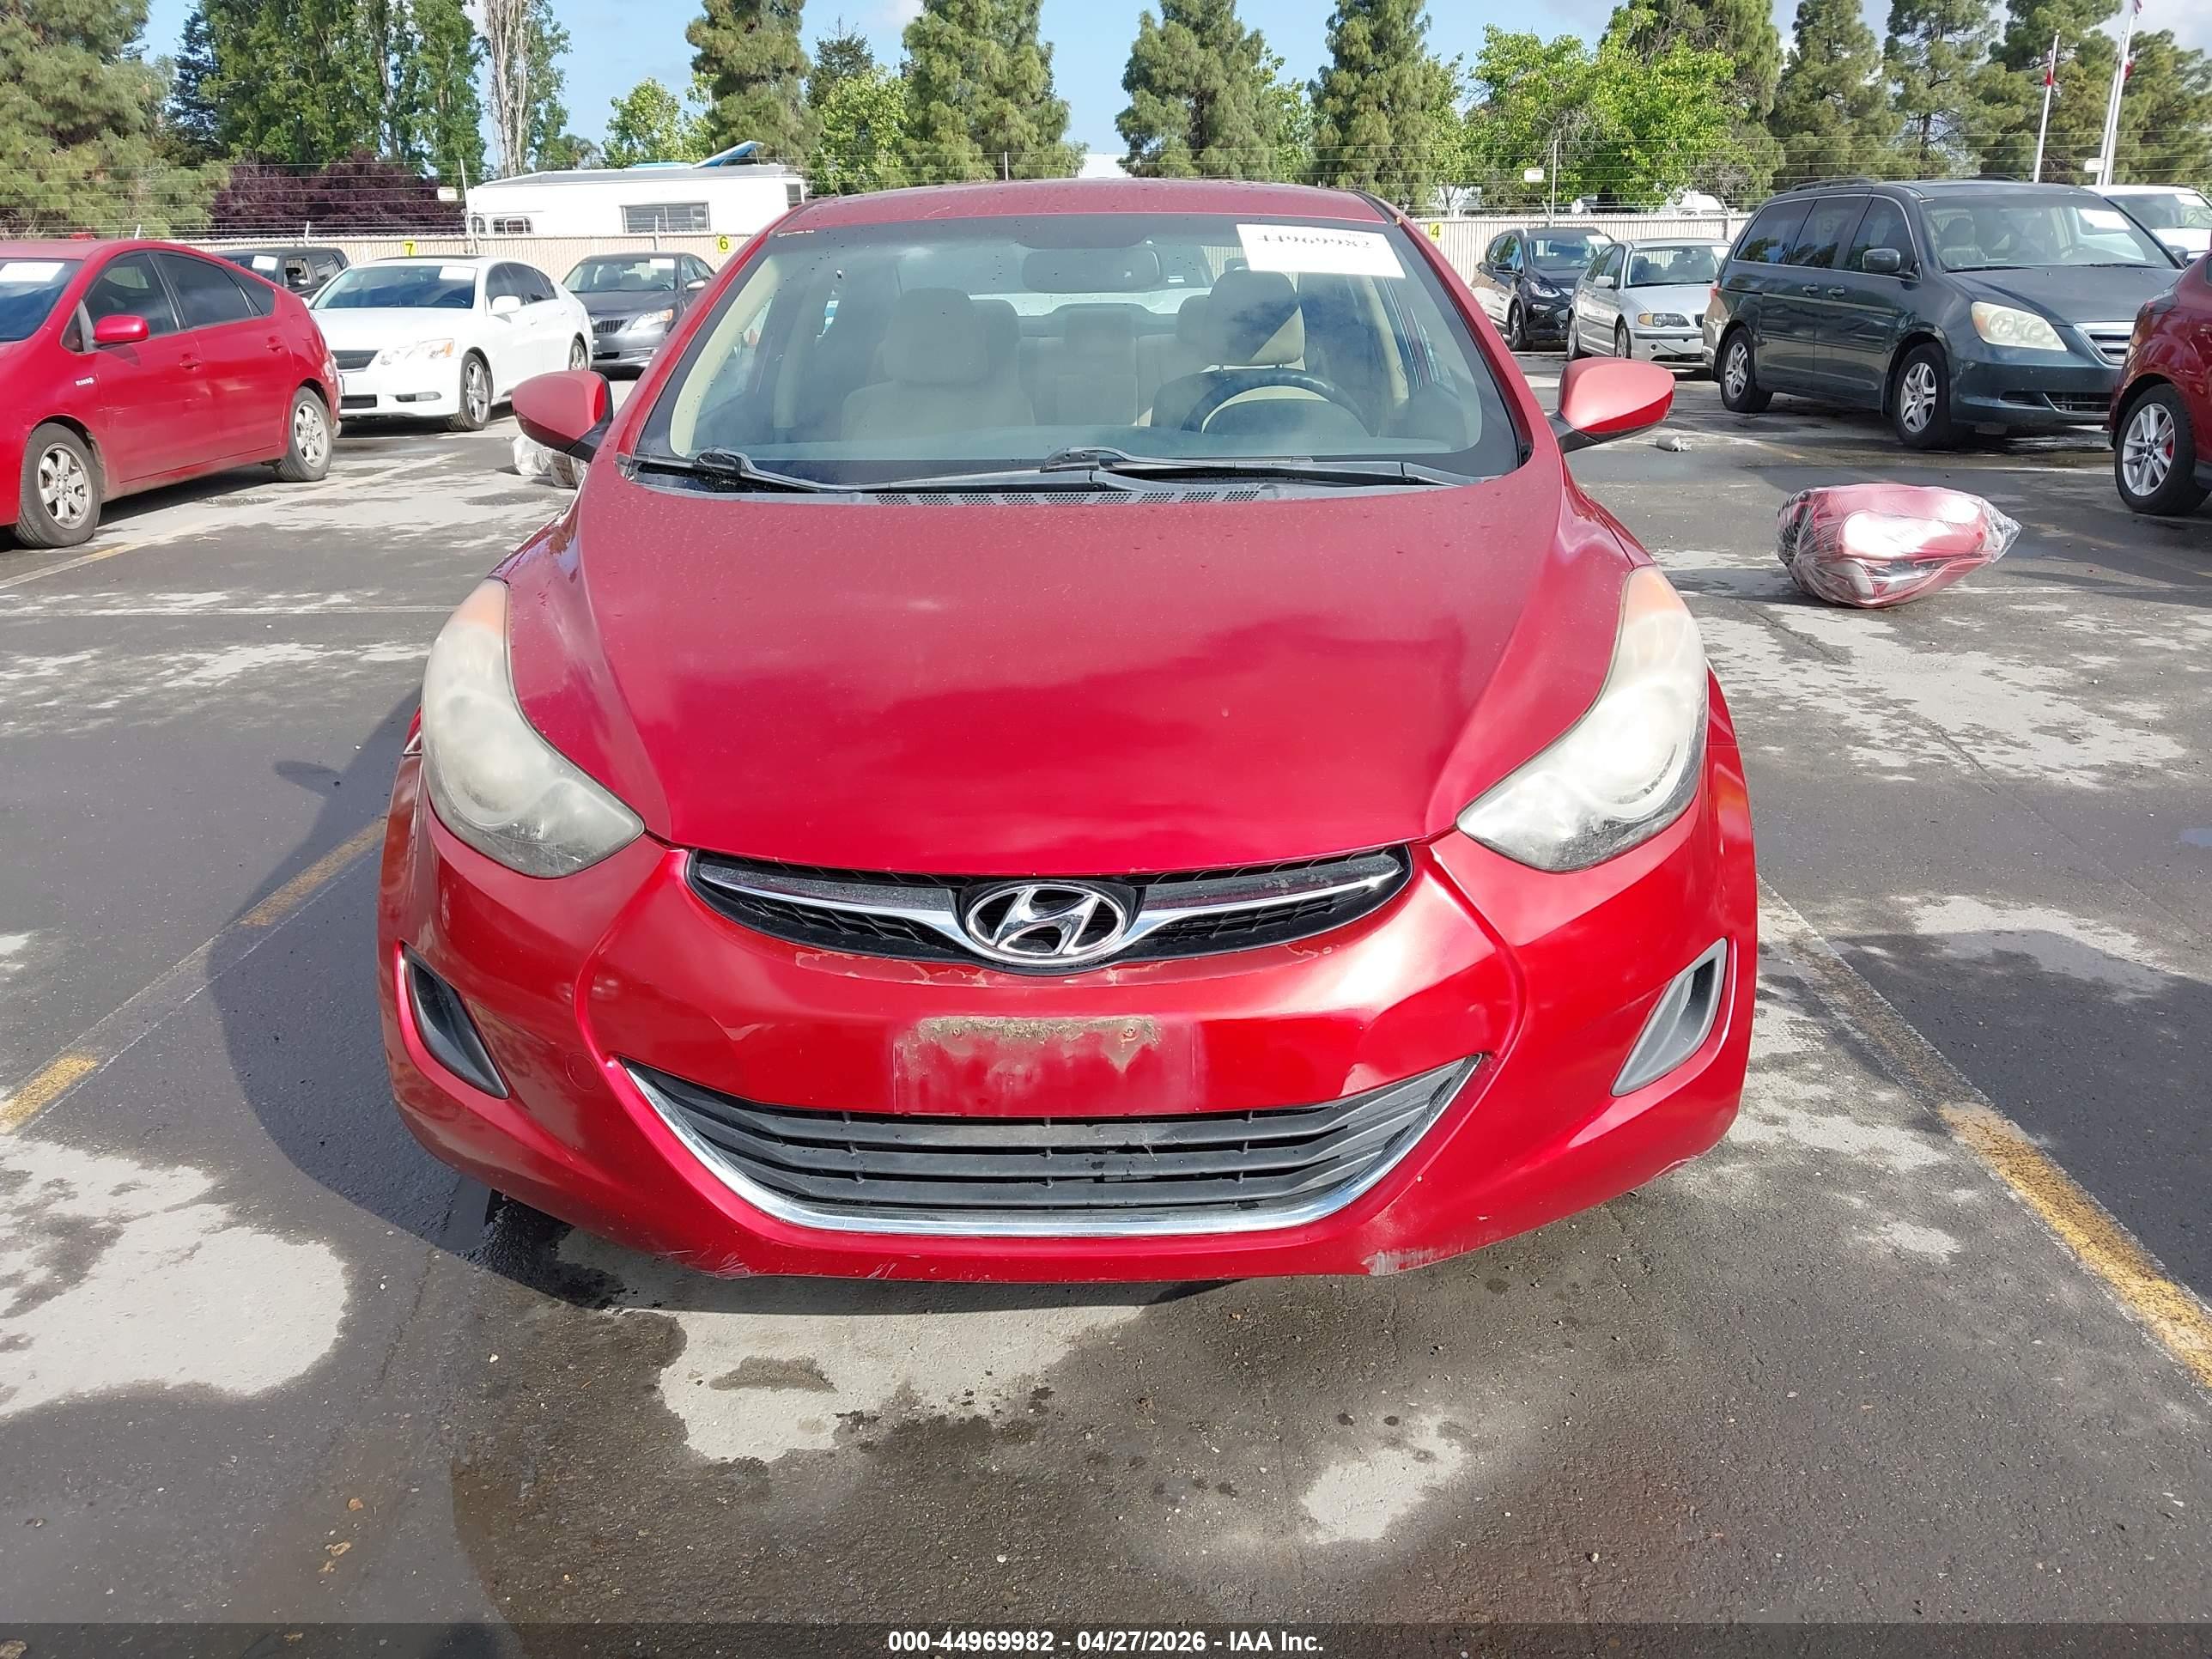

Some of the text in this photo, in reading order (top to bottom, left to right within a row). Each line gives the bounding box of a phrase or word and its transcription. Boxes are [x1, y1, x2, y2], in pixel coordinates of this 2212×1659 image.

[1431, 224, 1441, 238] 4
[404, 242, 414, 256] 7
[720, 235, 728, 250] 6
